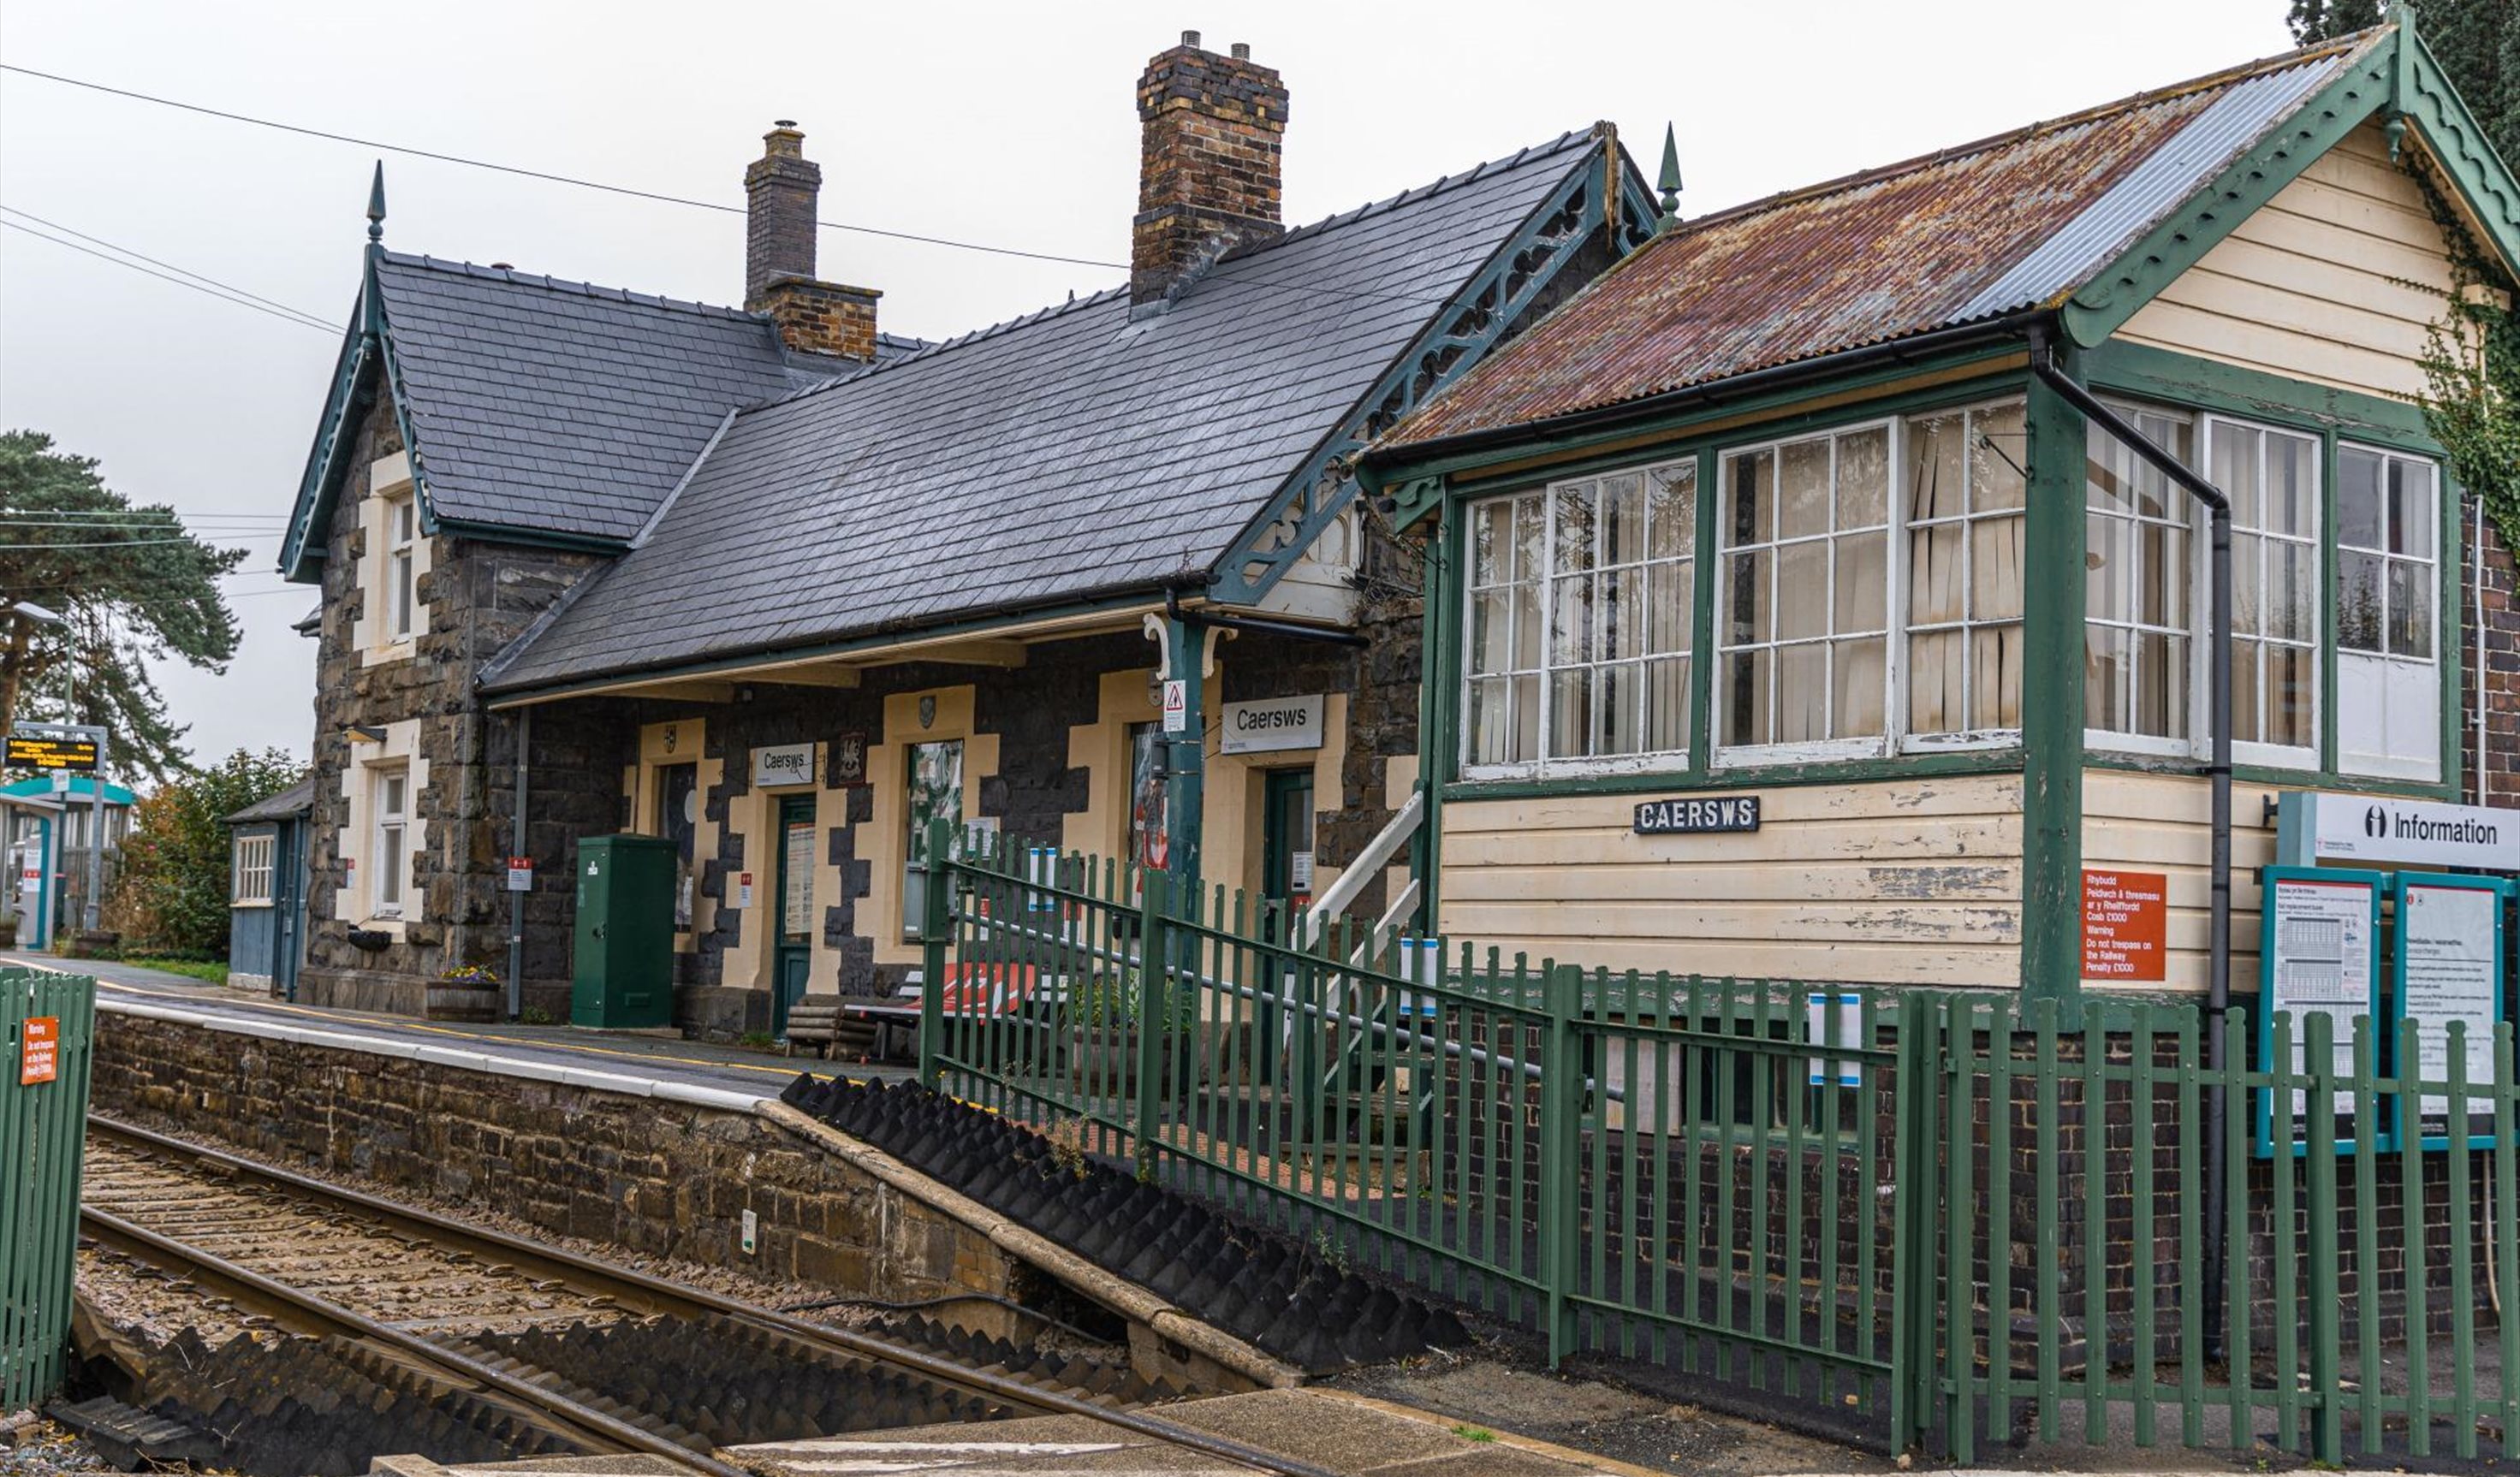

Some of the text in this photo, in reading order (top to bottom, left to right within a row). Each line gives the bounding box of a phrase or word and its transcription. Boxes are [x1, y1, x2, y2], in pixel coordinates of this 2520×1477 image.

[1237, 709, 1307, 731] Caersws
[764, 752, 805, 769] Caersws
[1641, 799, 1752, 828] CAERSWS
[2395, 812, 2498, 845] Information
[2086, 875, 2117, 887] Rhybudd
[2096, 901, 2102, 911] y
[2086, 911, 2127, 922] Cosb £1000
[2086, 924, 2114, 937] Warning
[2086, 938, 2096, 948] Do
[2098, 940, 2110, 948] not
[2112, 940, 2142, 951] trespass
[2086, 950, 2126, 963] the Railway
[2086, 962, 2134, 974] Penalty £1000
